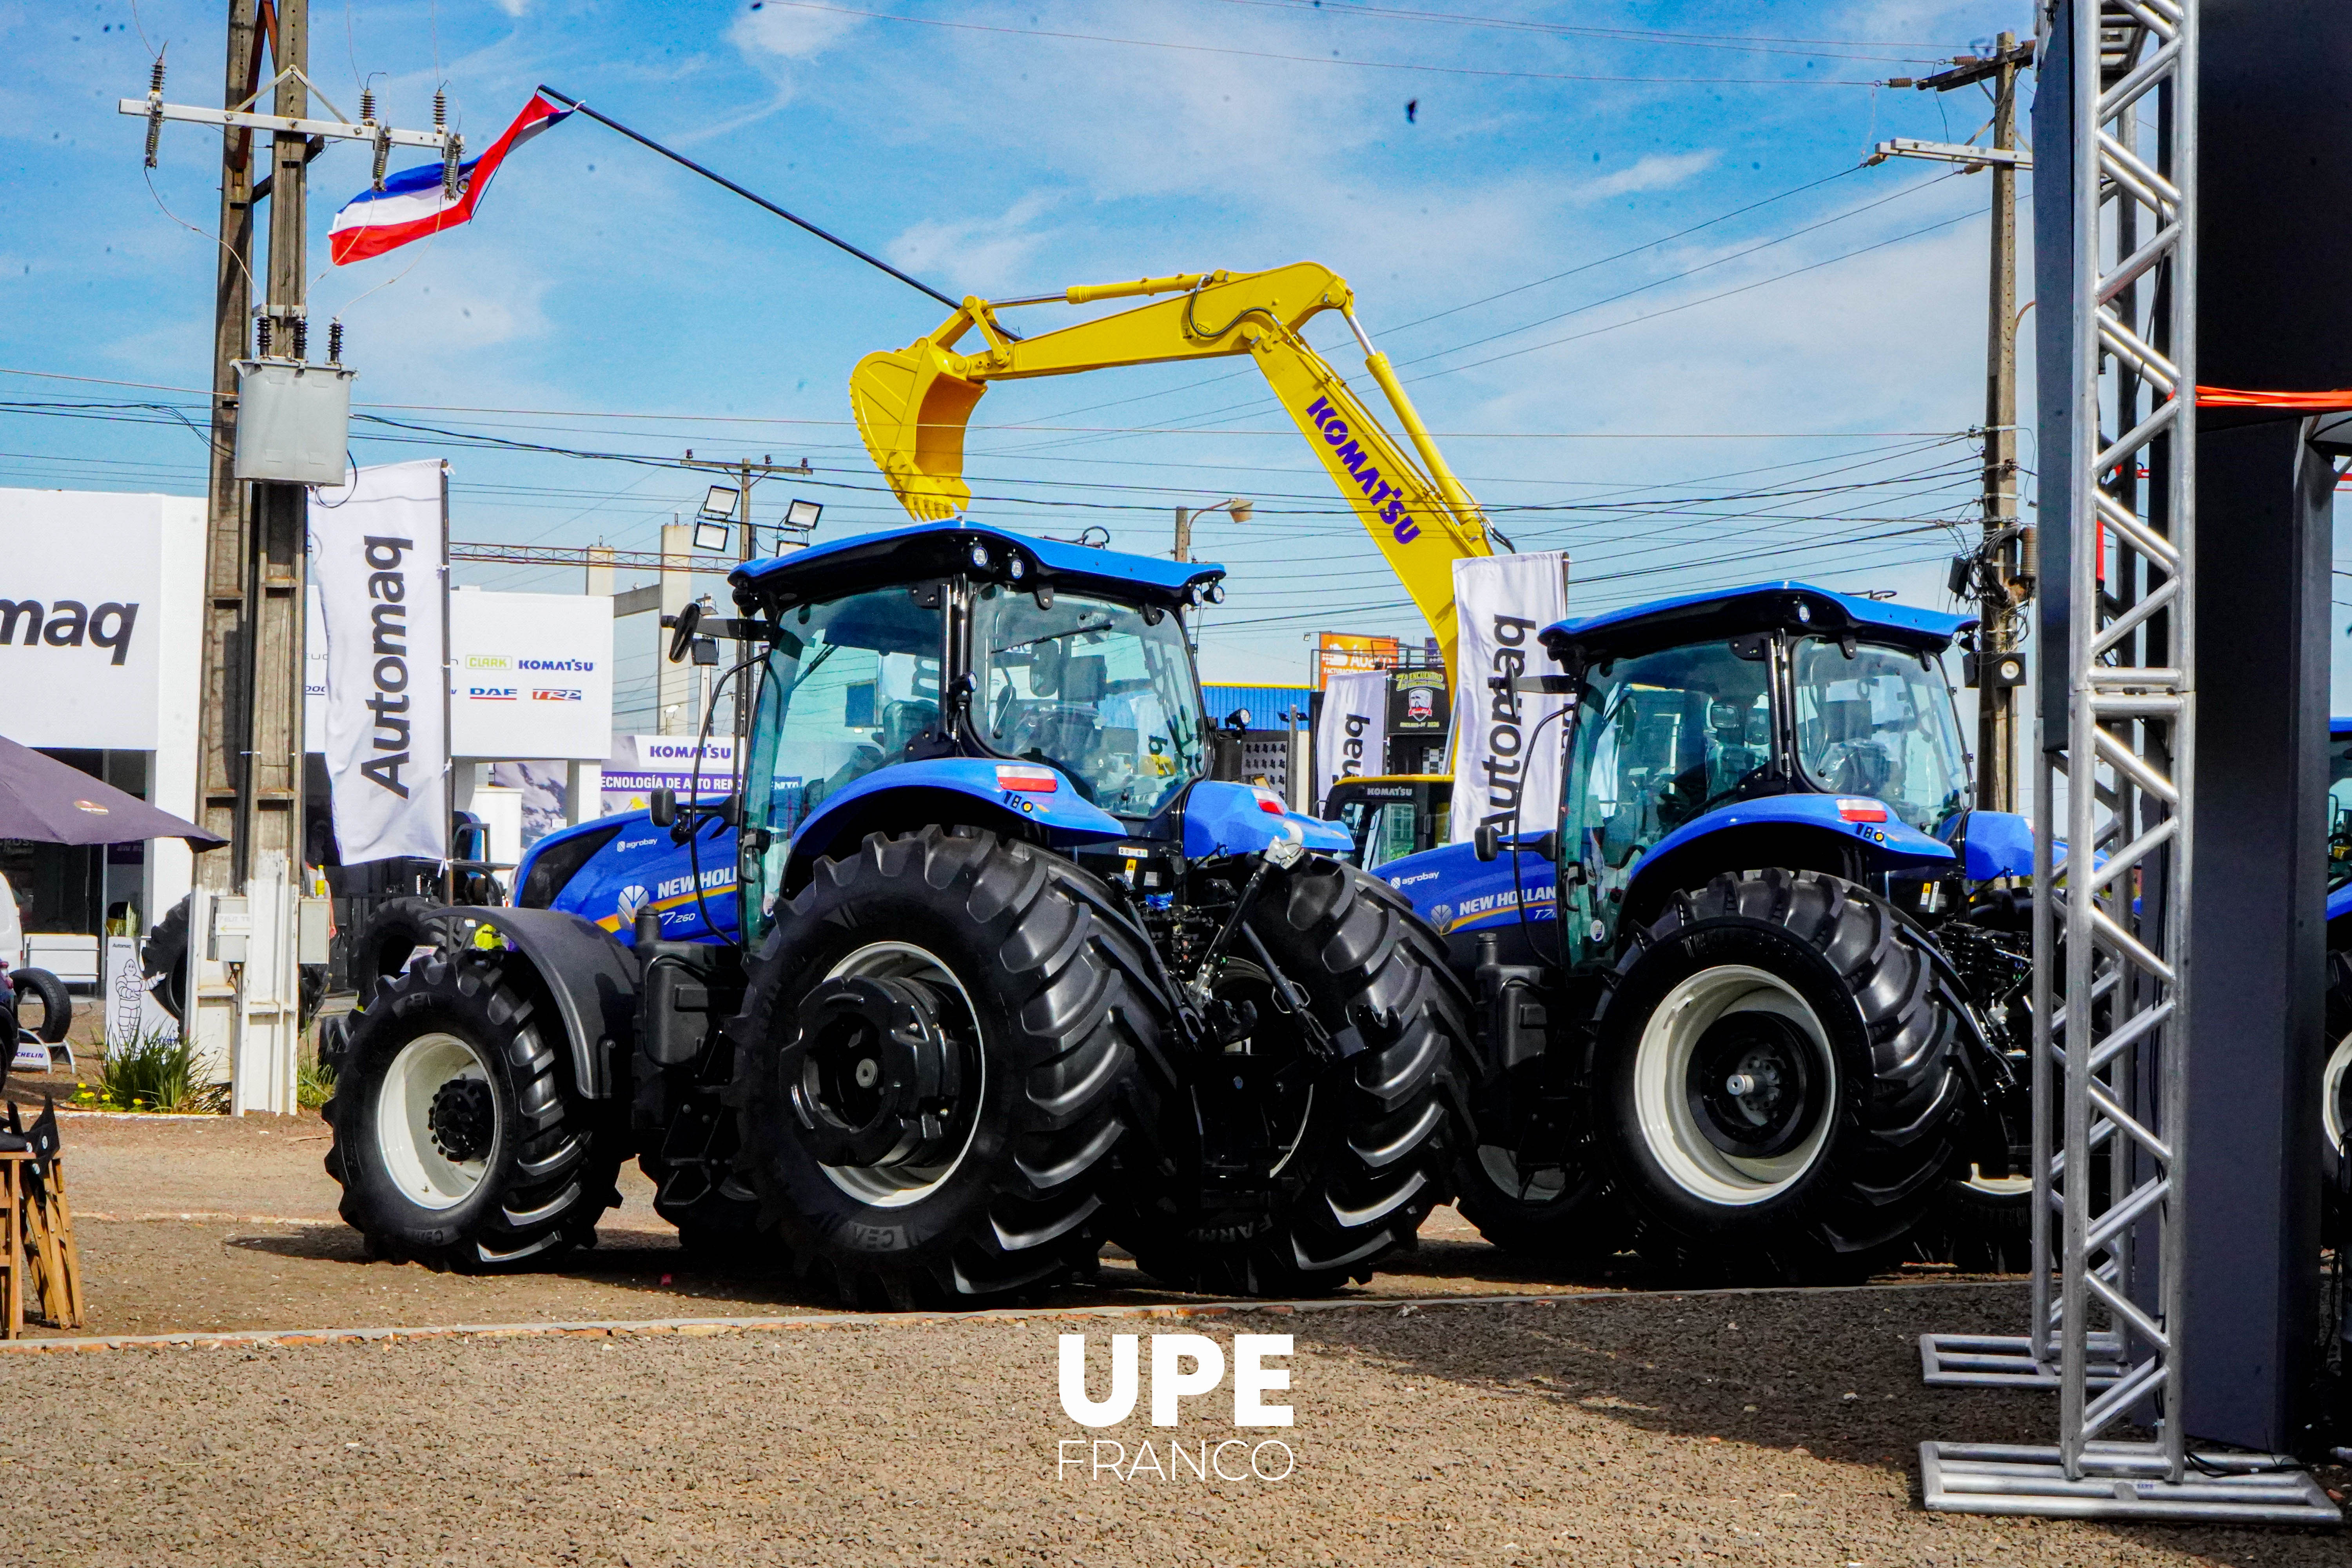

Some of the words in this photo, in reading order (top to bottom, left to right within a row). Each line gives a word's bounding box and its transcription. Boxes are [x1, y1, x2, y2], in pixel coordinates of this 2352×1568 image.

[1306, 395, 1421, 544] KOMATSU
[361, 535, 413, 800] Automaq
[469, 657, 507, 668] CLARK
[519, 659, 593, 671] KOMATSU
[650, 744, 731, 759] KOMATSU
[601, 775, 663, 788] ECNOLOGÍA
[666, 778, 681, 788] DE
[682, 778, 711, 790] ATO
[1367, 786, 1412, 796] KOMATSU
[626, 838, 658, 850] agrobay
[1402, 871, 1439, 886] agrobay
[658, 875, 695, 899] NEW
[1459, 895, 1495, 916] NEW
